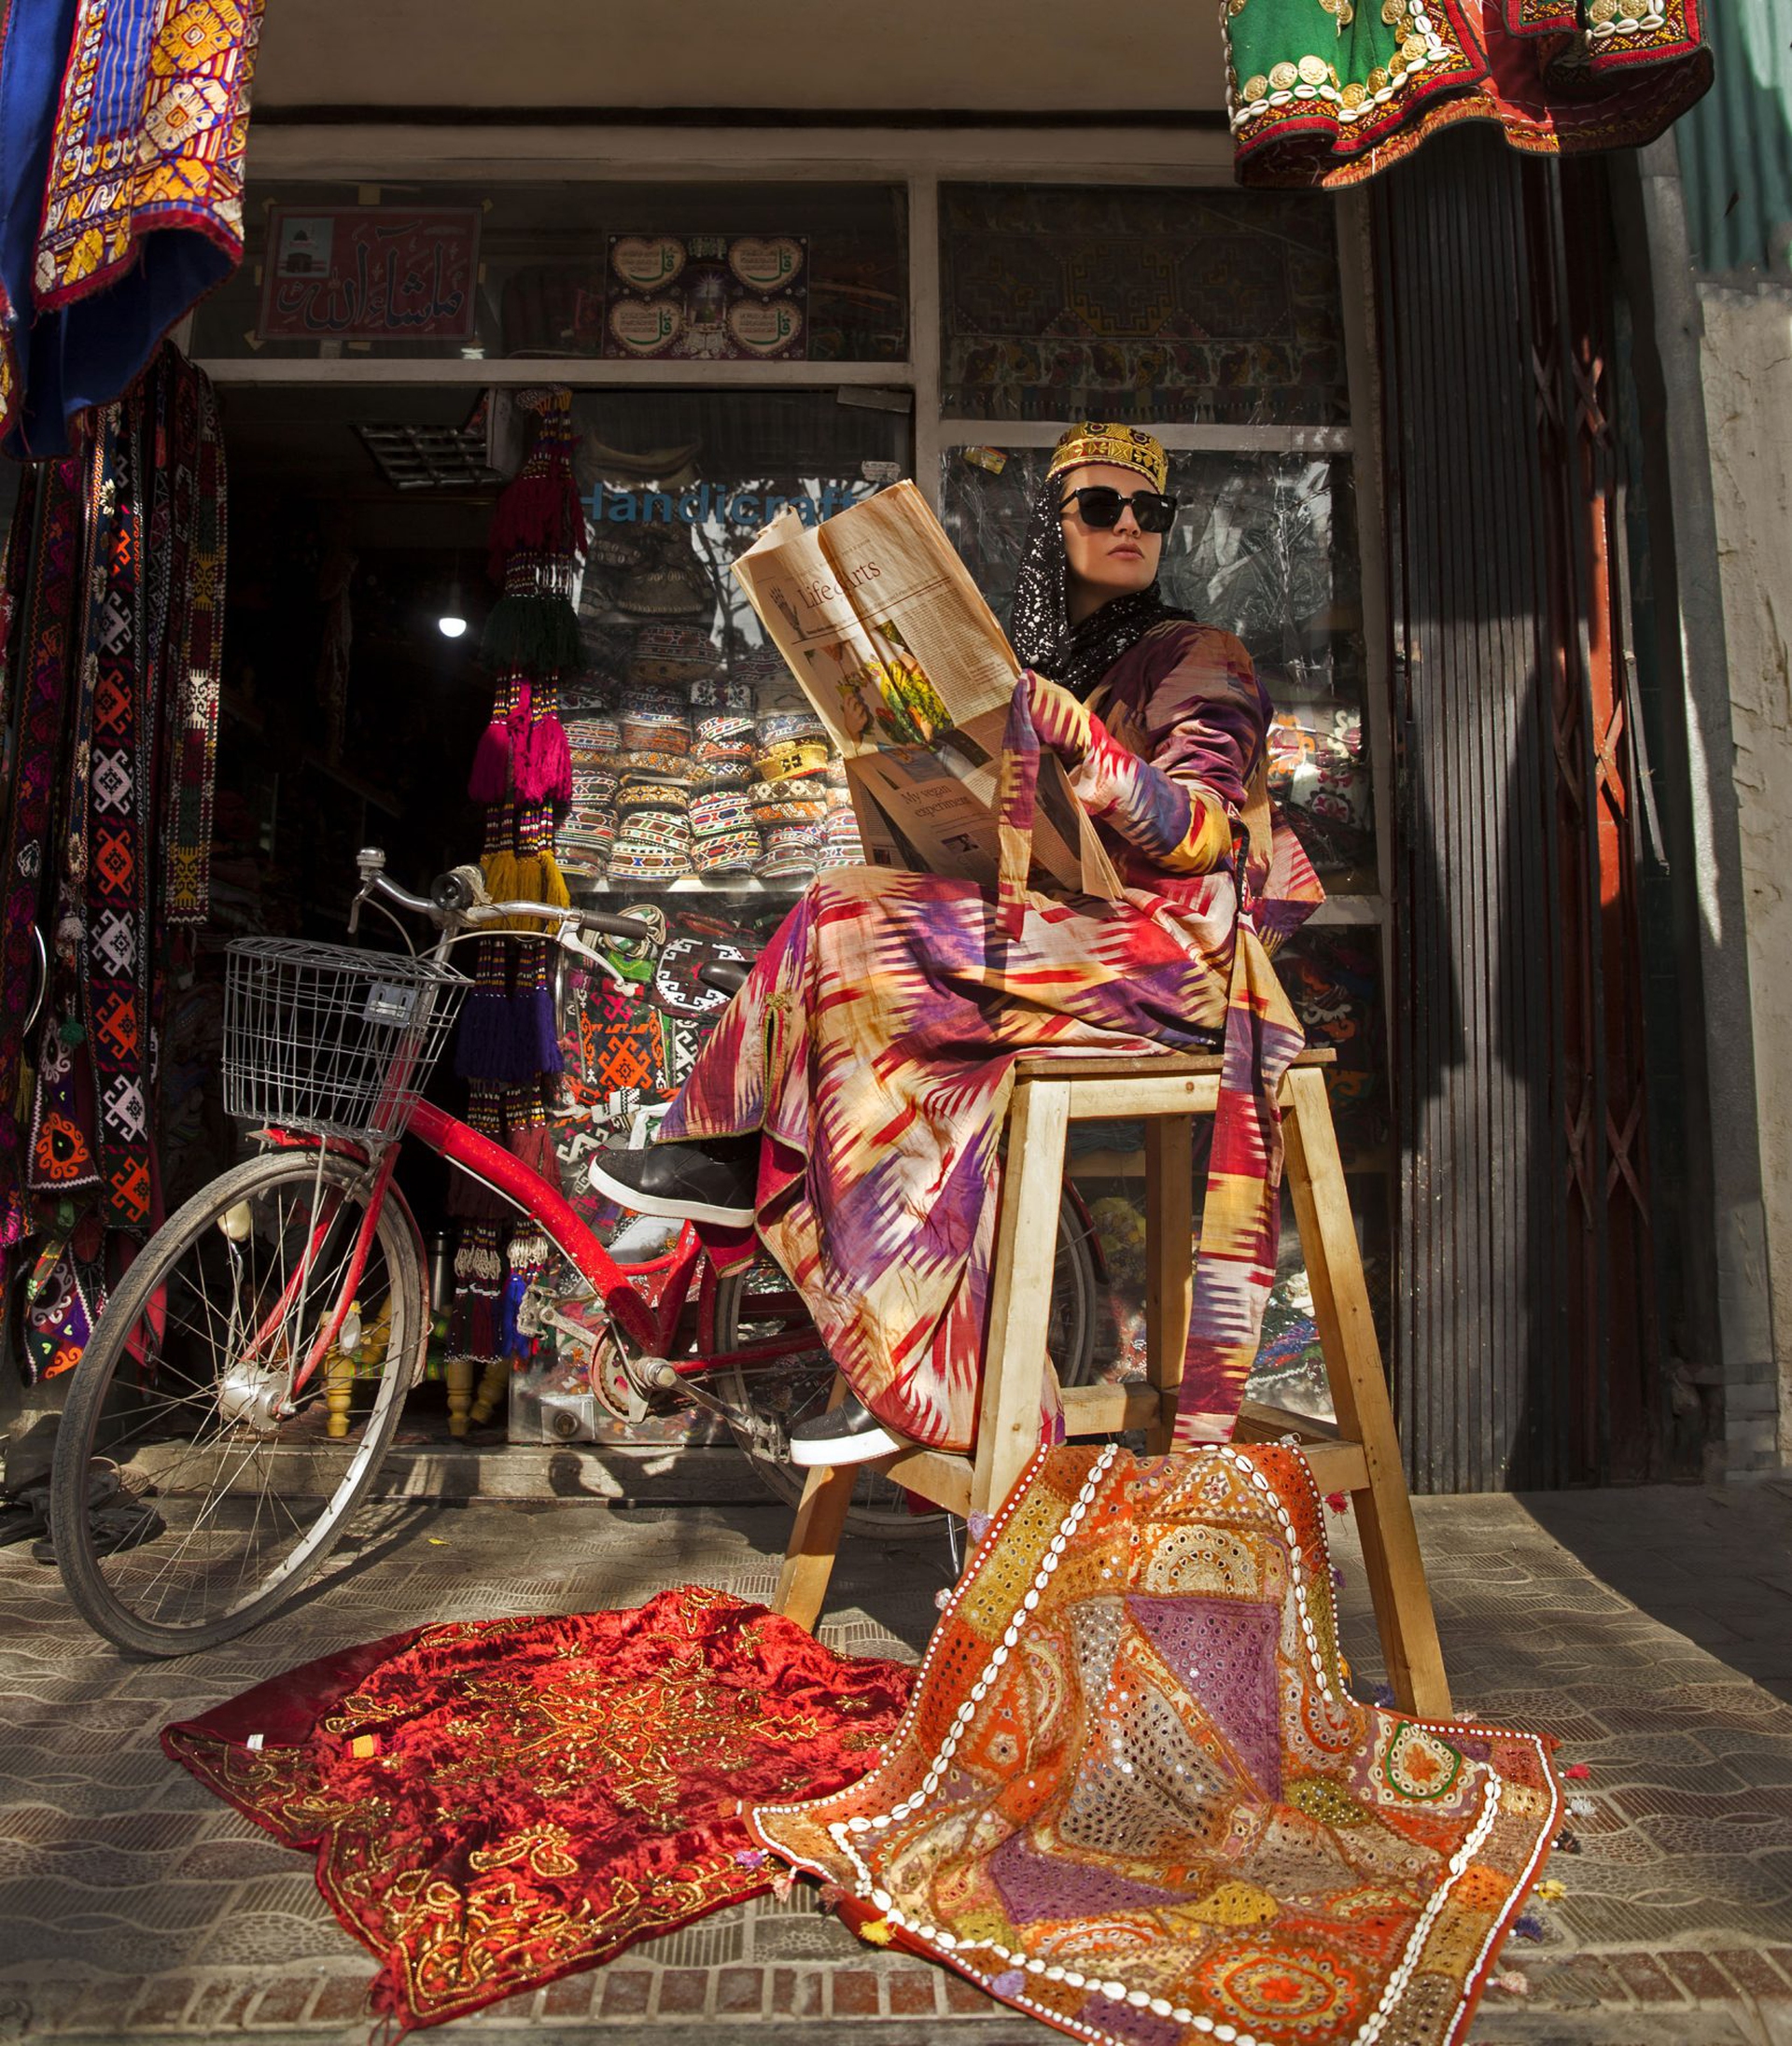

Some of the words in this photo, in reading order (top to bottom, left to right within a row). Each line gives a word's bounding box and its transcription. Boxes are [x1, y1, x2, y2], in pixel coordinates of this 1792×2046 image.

[798, 580, 834, 609] Life
[842, 562, 881, 590] Arts
[901, 791, 922, 805] My
[920, 784, 952, 799] vegan
